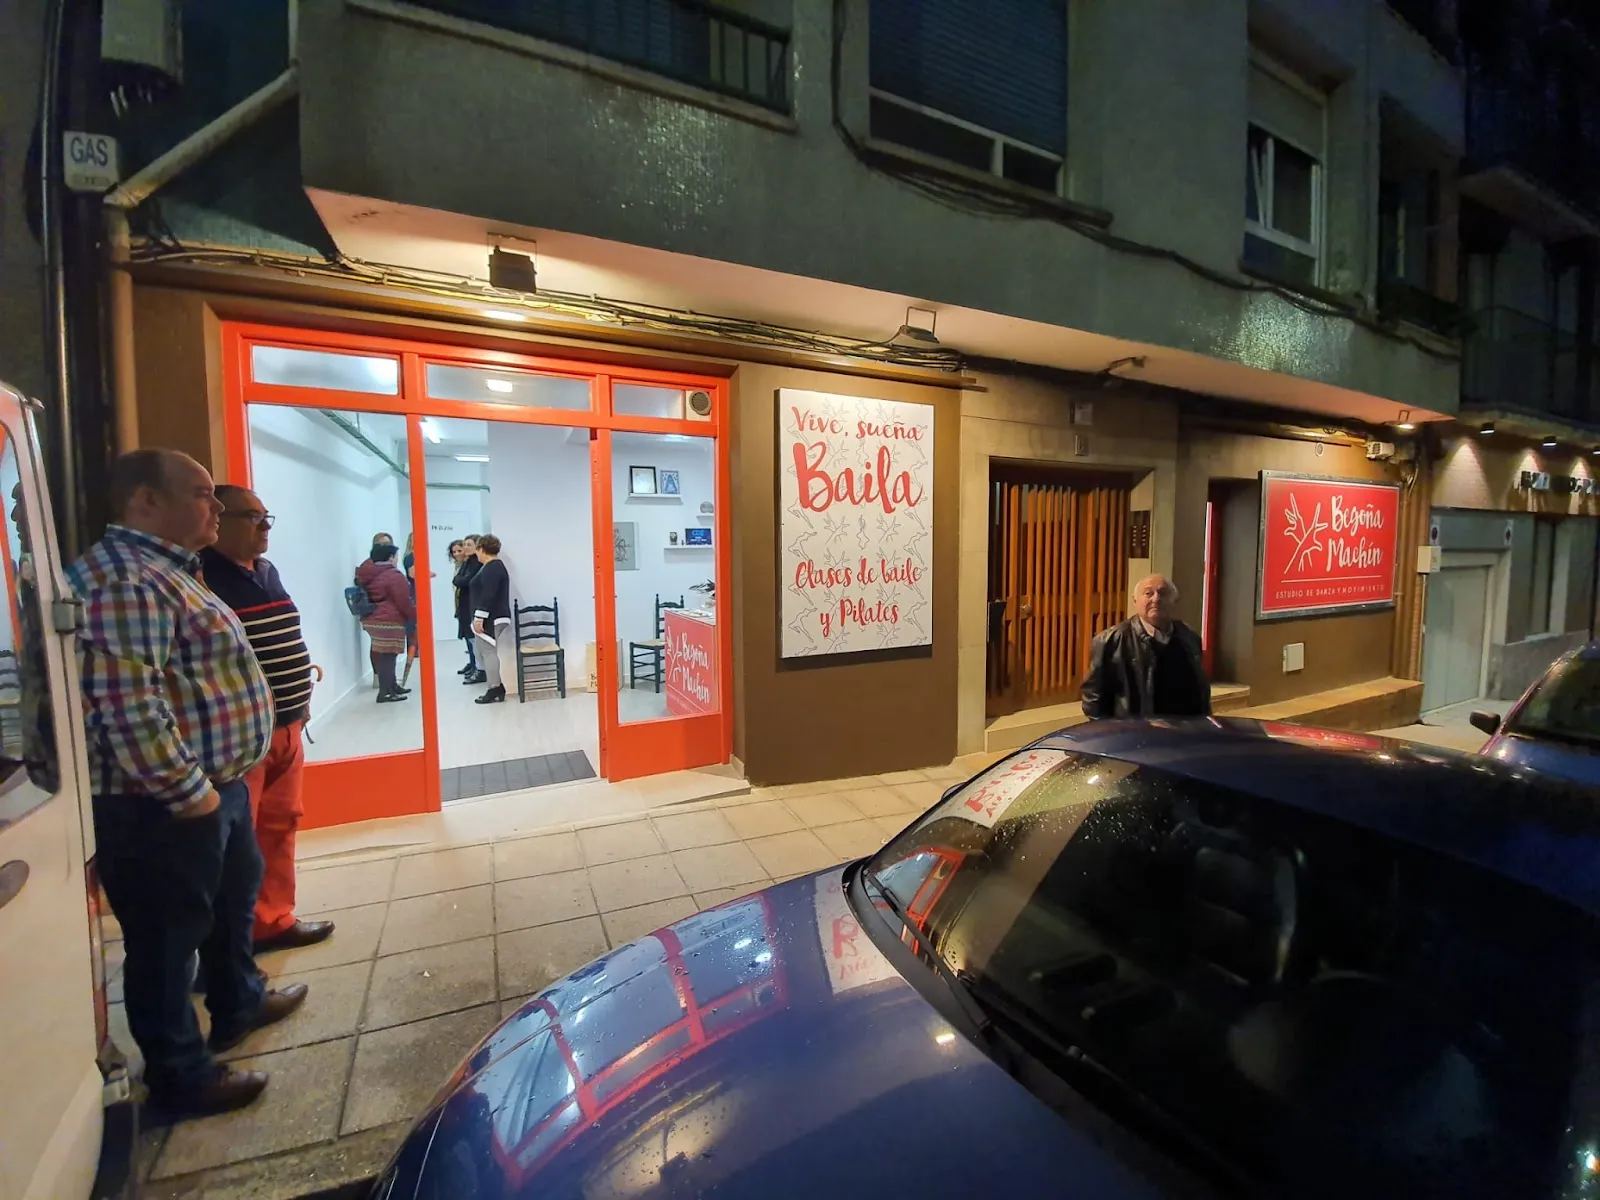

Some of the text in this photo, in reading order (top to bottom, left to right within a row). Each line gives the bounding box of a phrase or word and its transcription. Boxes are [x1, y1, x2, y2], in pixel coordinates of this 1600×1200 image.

[70, 136, 108, 167] GAS
[856, 421, 923, 441] sueña
[792, 441, 923, 514] Baila
[1331, 495, 1384, 537] Begoña
[795, 557, 921, 589] Clases de baile
[1275, 589, 1304, 600] ESTUDIO
[1316, 587, 1336, 597] DANZA
[1342, 584, 1385, 595] MOVIMIENTO
[820, 598, 899, 638] y Pilates
